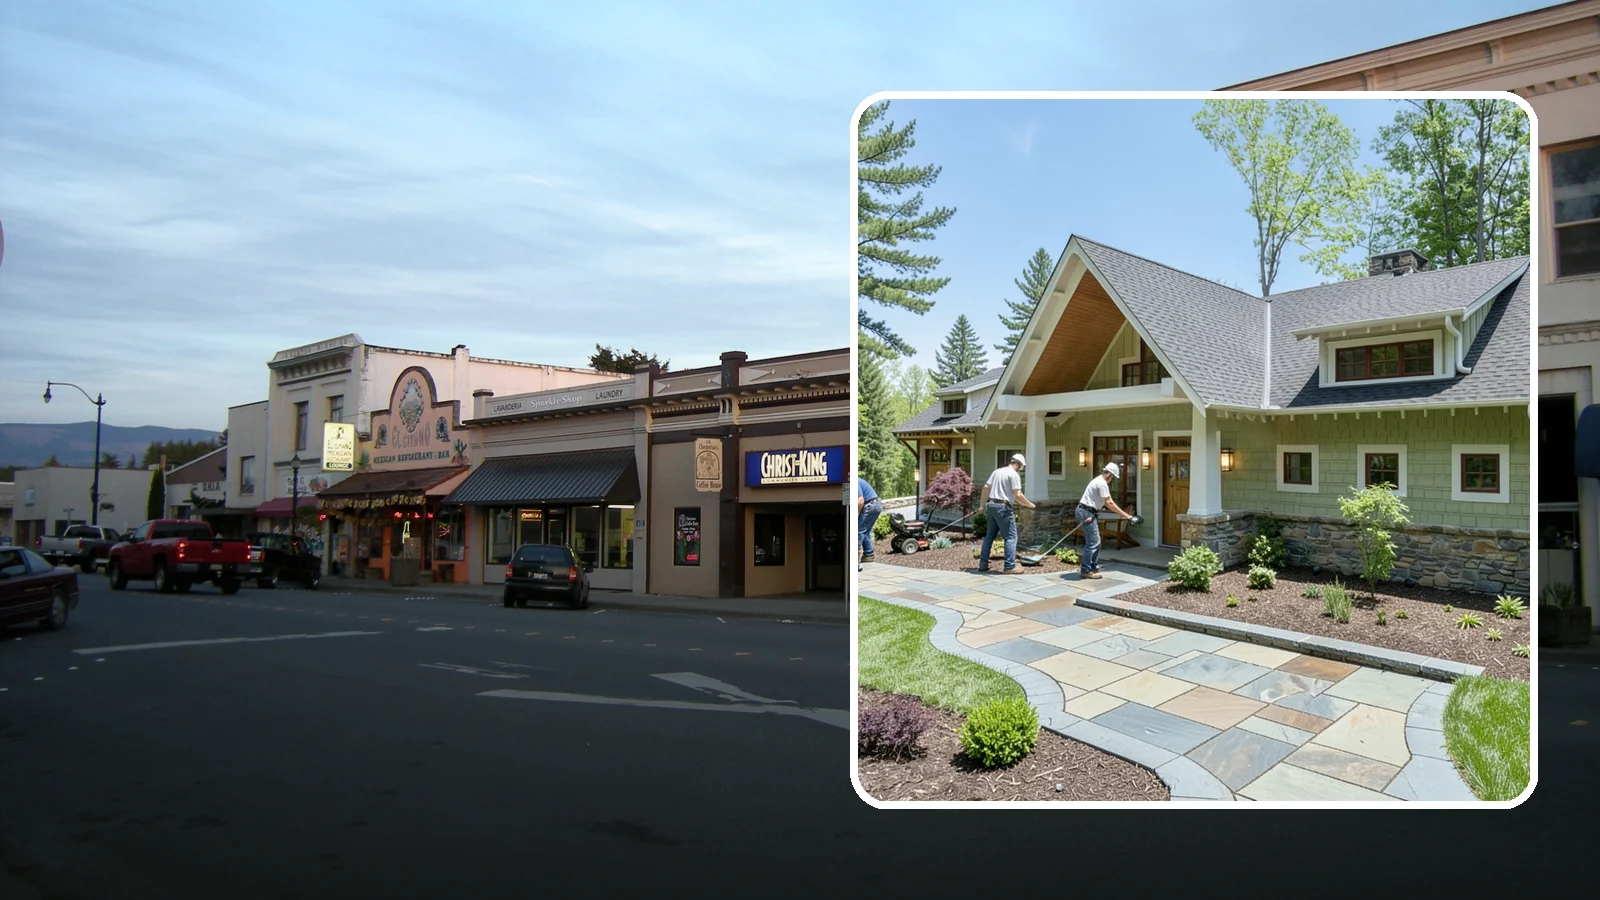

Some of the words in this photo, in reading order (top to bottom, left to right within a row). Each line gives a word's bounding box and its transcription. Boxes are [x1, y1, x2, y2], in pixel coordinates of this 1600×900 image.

[530, 398, 562, 409] Sparkle
[561, 394, 583, 404] Shop
[595, 389, 624, 400] LAUNDRY
[493, 402, 522, 412] LAVANDERIA
[373, 455, 396, 464] MEXICAN
[397, 451, 433, 462] RESTAURANT
[437, 450, 450, 459] BAR
[760, 452, 797, 478] CHRIST
[798, 450, 827, 476] KING
